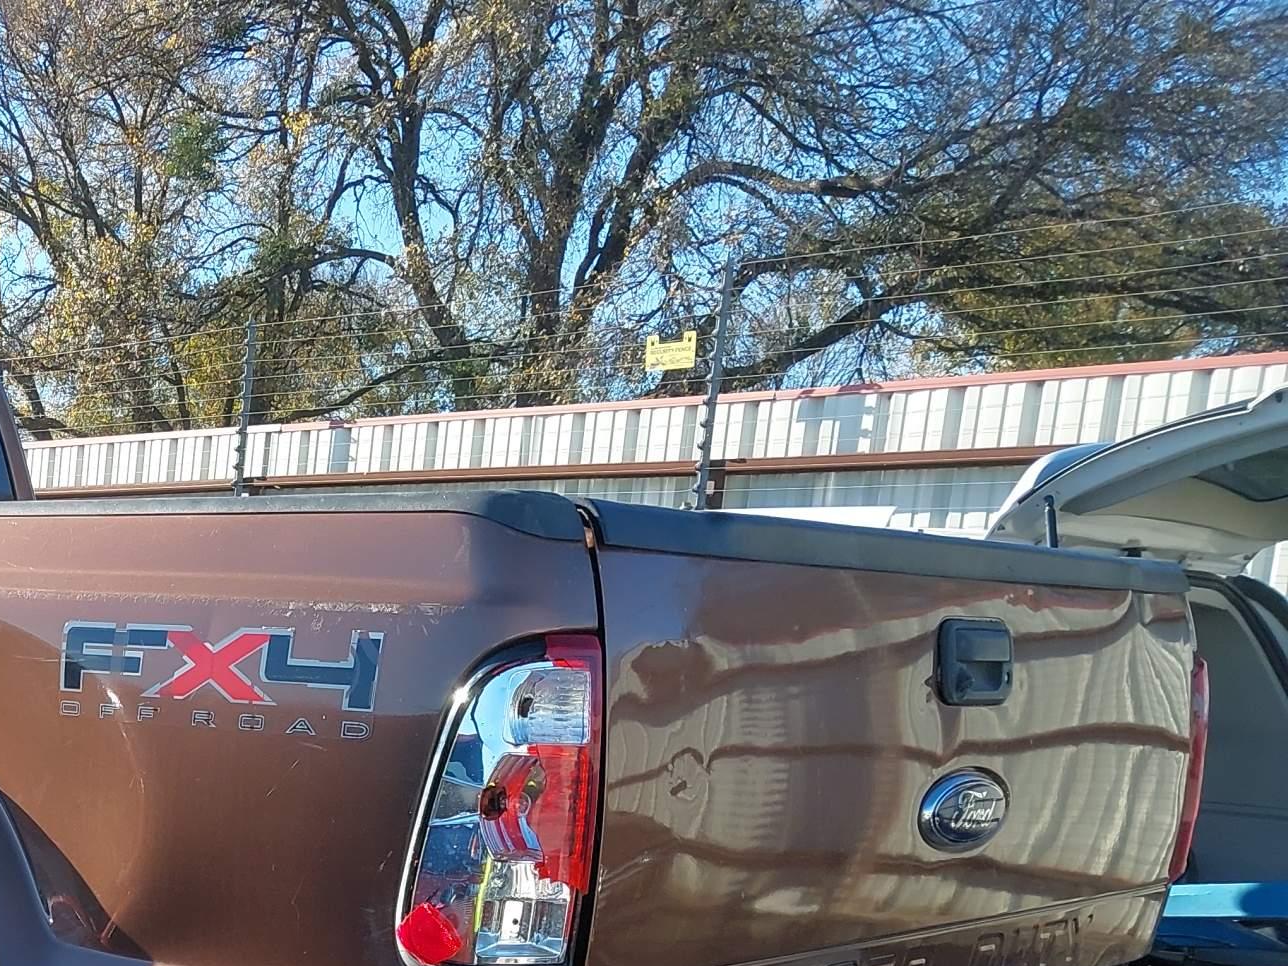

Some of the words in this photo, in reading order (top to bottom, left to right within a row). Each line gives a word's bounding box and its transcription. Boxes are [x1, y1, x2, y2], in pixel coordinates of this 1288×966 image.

[60, 620, 386, 712] FX4
[59, 699, 160, 722] OFF
[191, 709, 370, 739] ROAD
